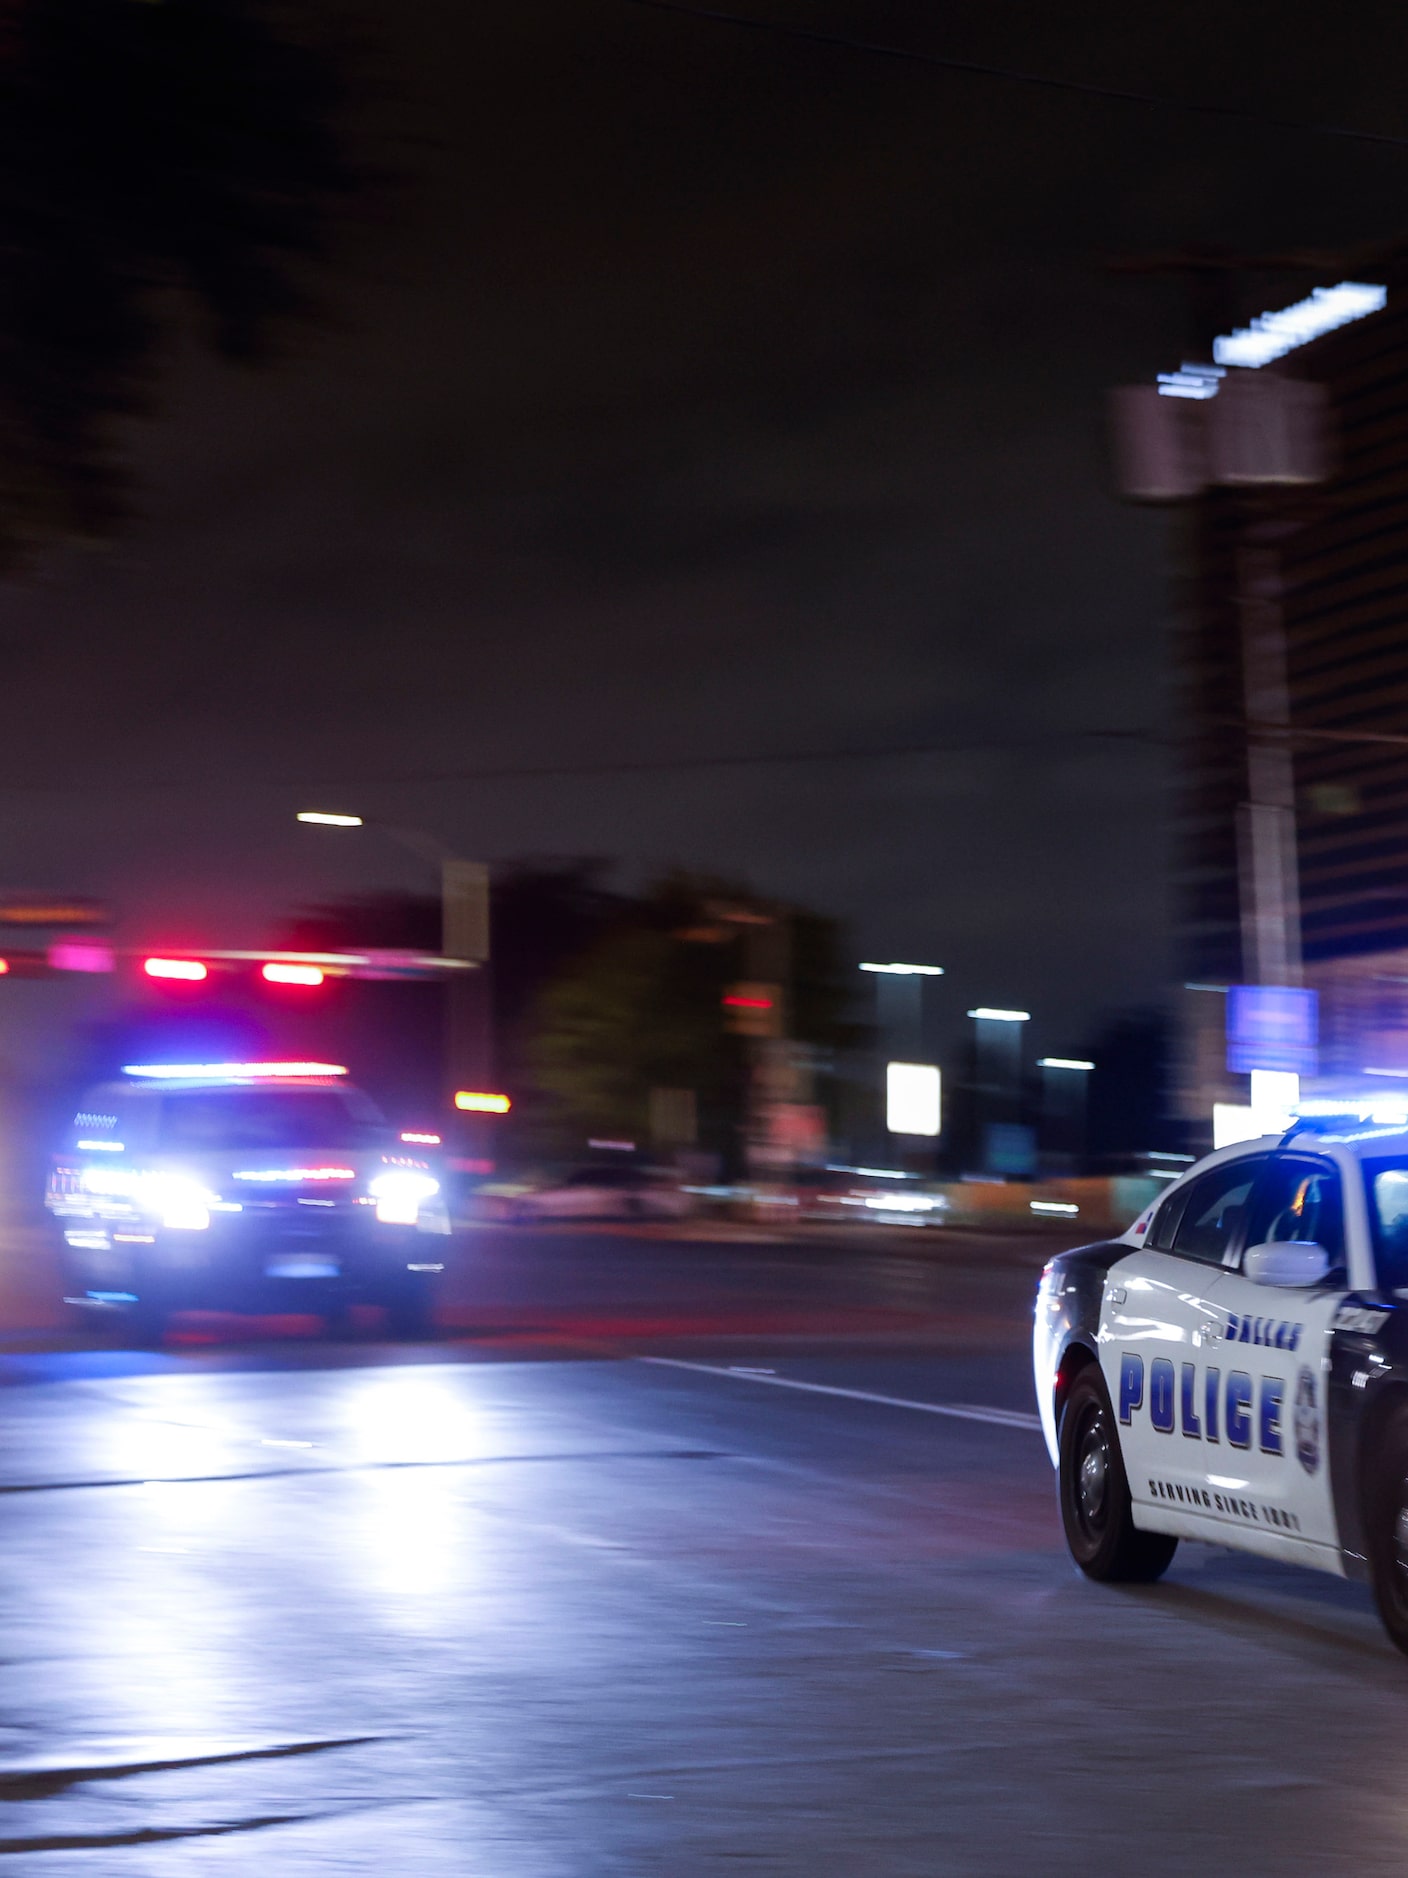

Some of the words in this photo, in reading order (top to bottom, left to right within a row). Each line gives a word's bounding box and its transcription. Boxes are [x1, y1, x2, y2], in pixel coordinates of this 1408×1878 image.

[1225, 1311, 1304, 1352] DALLAS
[1119, 1351, 1286, 1457] POLICE
[1148, 1479, 1212, 1508] SERVING
[1214, 1492, 1260, 1521] SINCE
